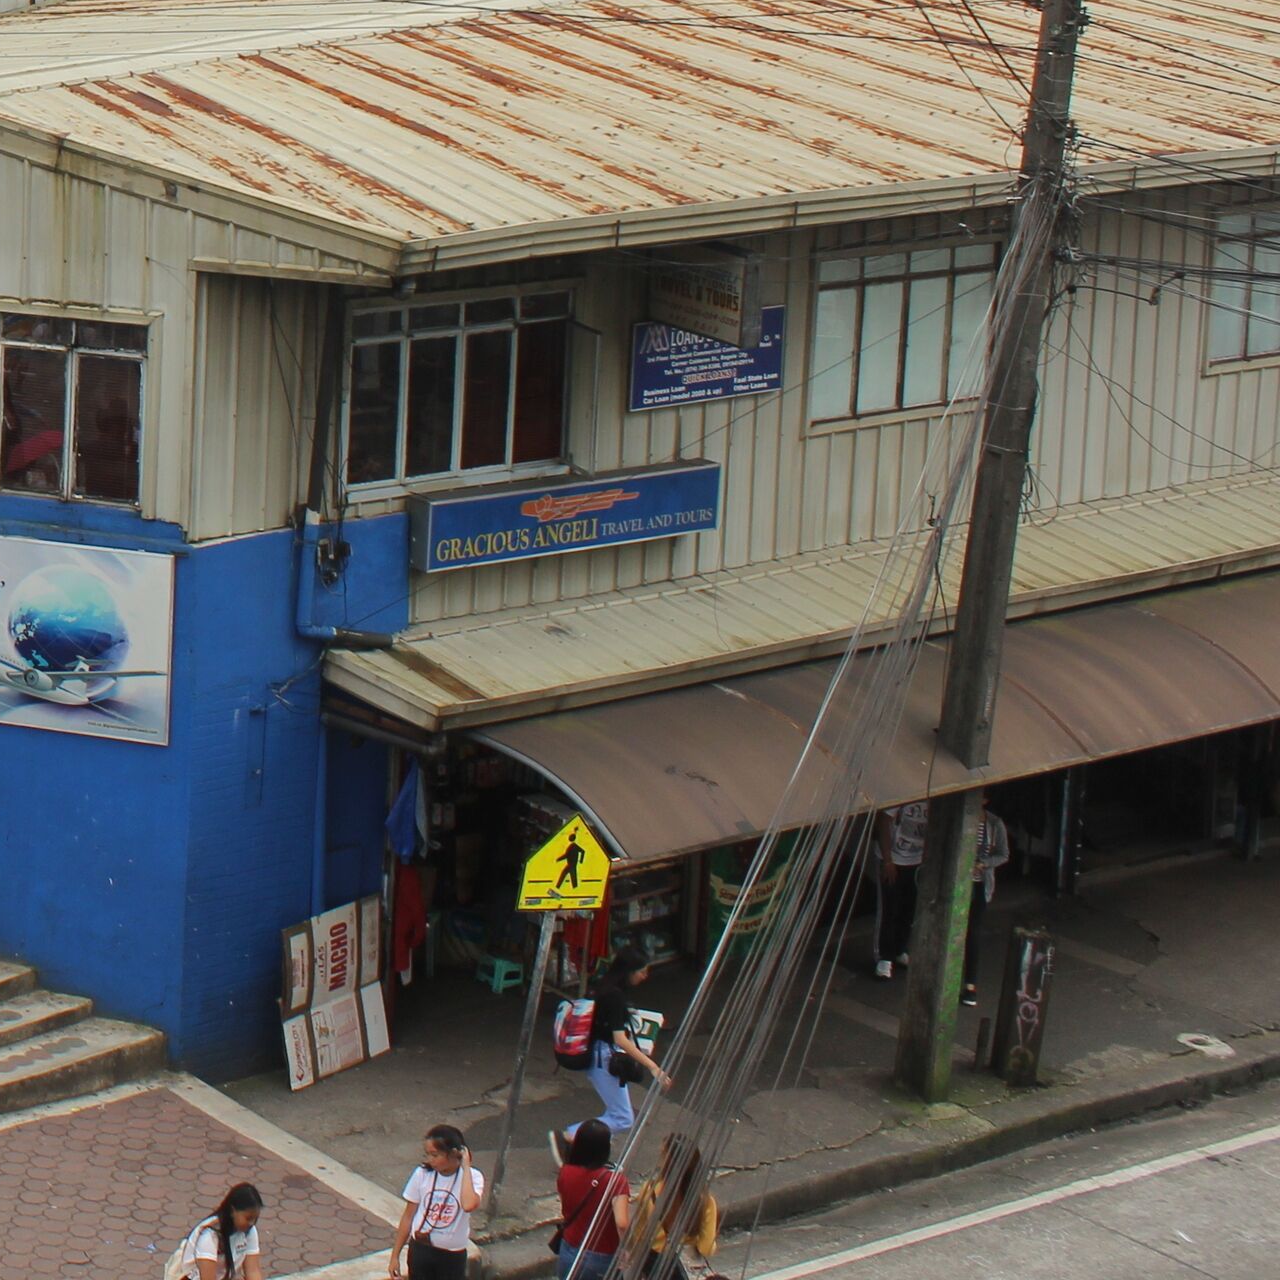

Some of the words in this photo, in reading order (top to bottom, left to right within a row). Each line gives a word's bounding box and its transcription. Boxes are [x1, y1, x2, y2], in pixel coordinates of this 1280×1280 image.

[705, 287, 739, 312] TOURS
[643, 387, 669, 397] Business
[670, 385, 686, 393] Loan
[435, 527, 529, 562] GRACIOUS
[533, 518, 599, 549] ANGELI
[601, 518, 643, 537] TRAVEL
[647, 515, 672, 532] AND
[674, 507, 713, 526] TOURS
[329, 921, 348, 992] MACHO
